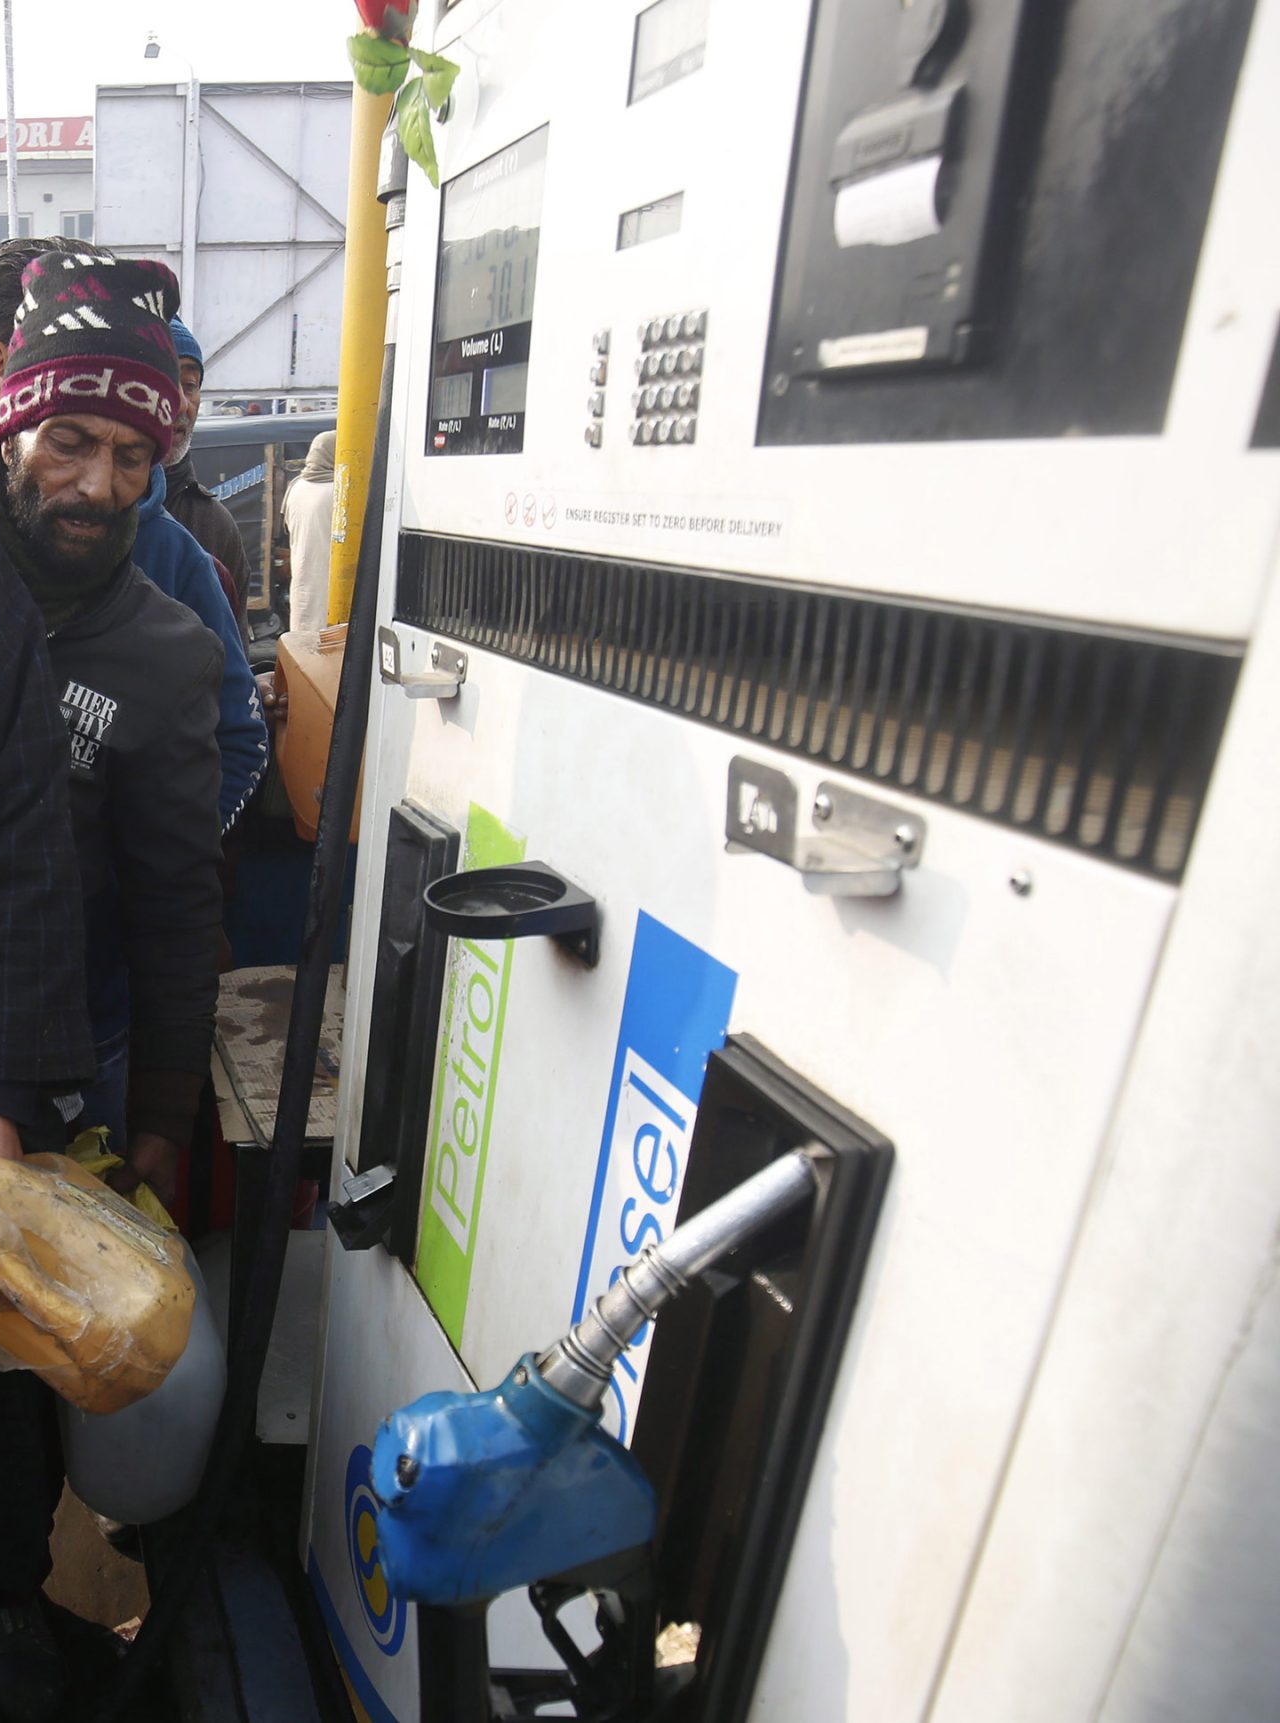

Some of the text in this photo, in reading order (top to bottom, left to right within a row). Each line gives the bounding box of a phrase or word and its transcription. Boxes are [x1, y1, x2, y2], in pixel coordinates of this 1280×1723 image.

[461, 330, 504, 358] Volume (L)
[488, 416, 500, 429] Rate
[565, 507, 784, 538] ENSURE REGISTER SET TO ZERO BEFORE DELIVERY
[61, 680, 118, 723] HIER
[74, 710, 112, 742] HY
[71, 733, 100, 765] RE
[434, 938, 500, 1229] Petrol
